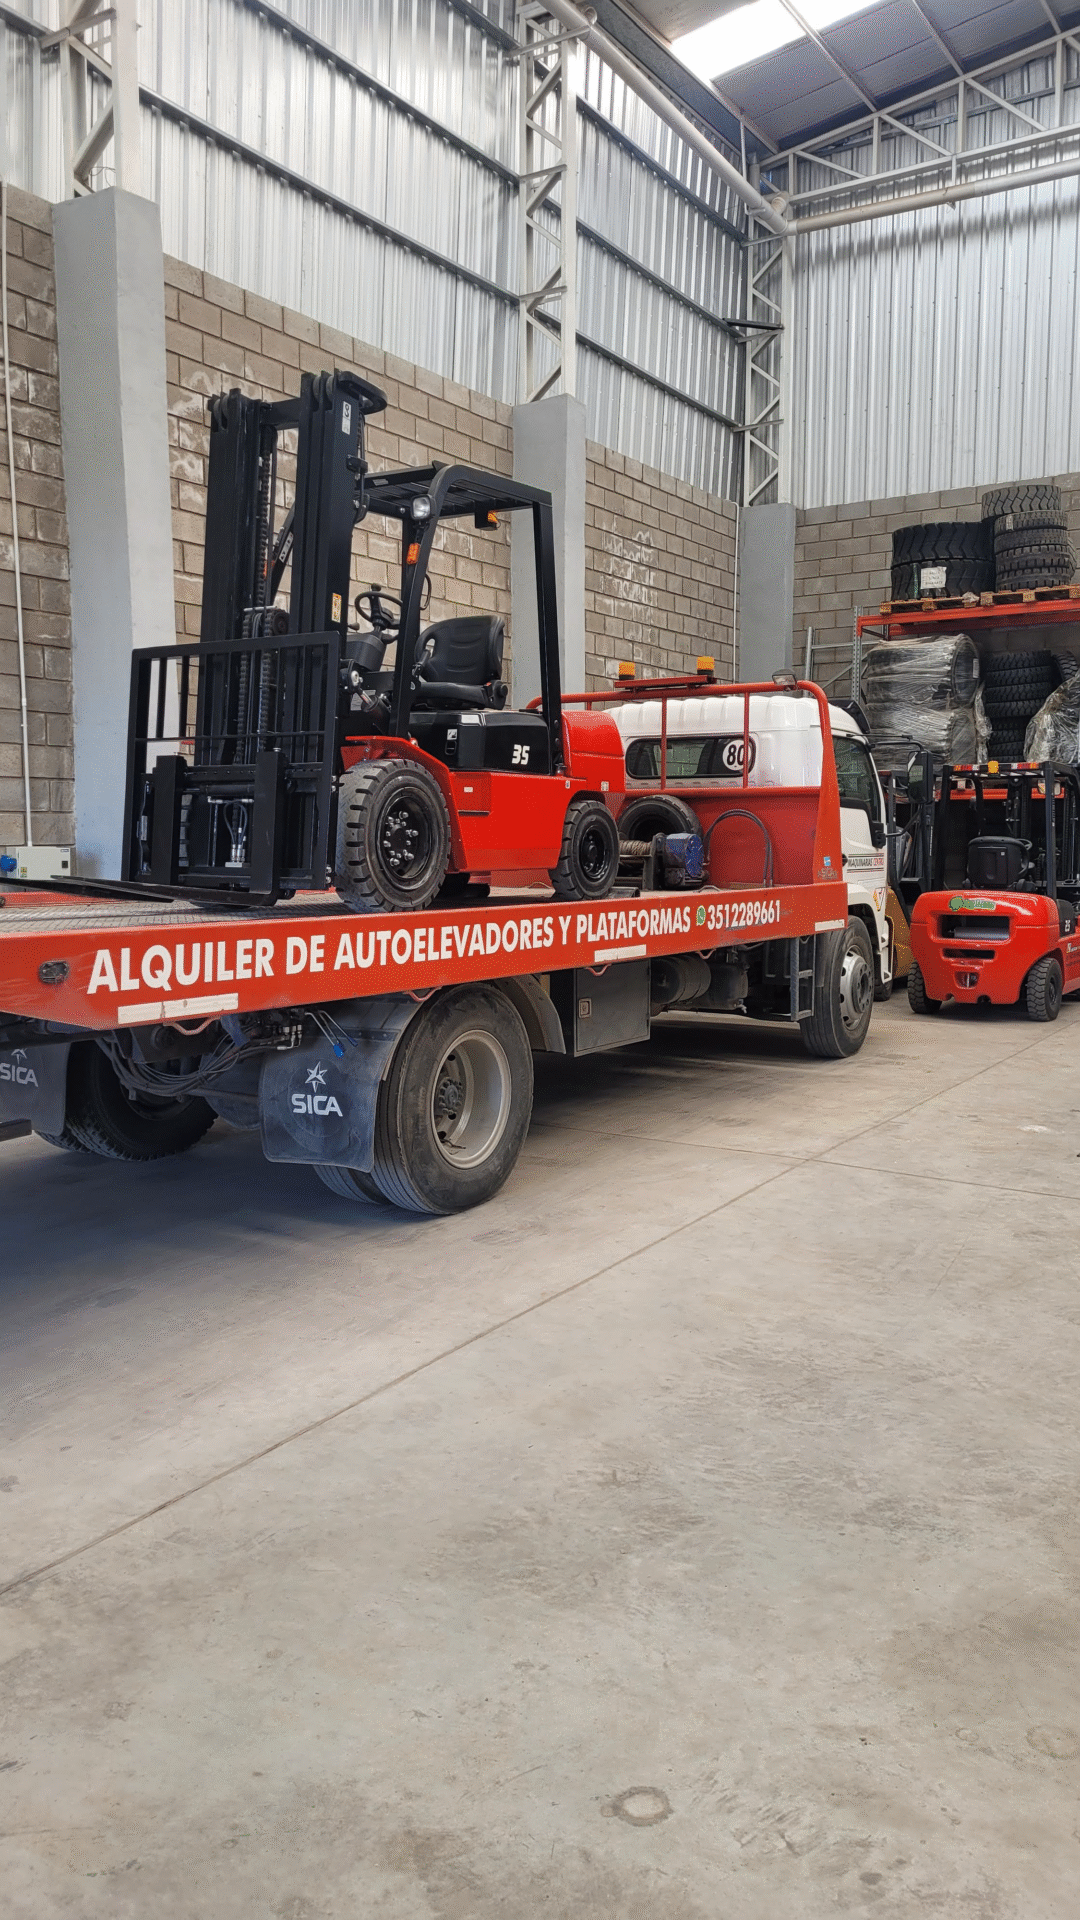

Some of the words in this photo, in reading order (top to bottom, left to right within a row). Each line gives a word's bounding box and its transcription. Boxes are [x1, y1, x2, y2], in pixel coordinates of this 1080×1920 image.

[512, 744, 530, 765] 35
[727, 744, 748, 765] 80
[87, 938, 275, 994] ALQUILER
[286, 934, 326, 975] DE
[333, 916, 554, 970] AUTOELEVADORES
[559, 915, 572, 945] Y
[576, 906, 691, 944] PLATAFORMAS
[707, 900, 781, 930] 3512289661
[0, 1062, 39, 1088] SICA
[291, 1093, 344, 1118] SICA
